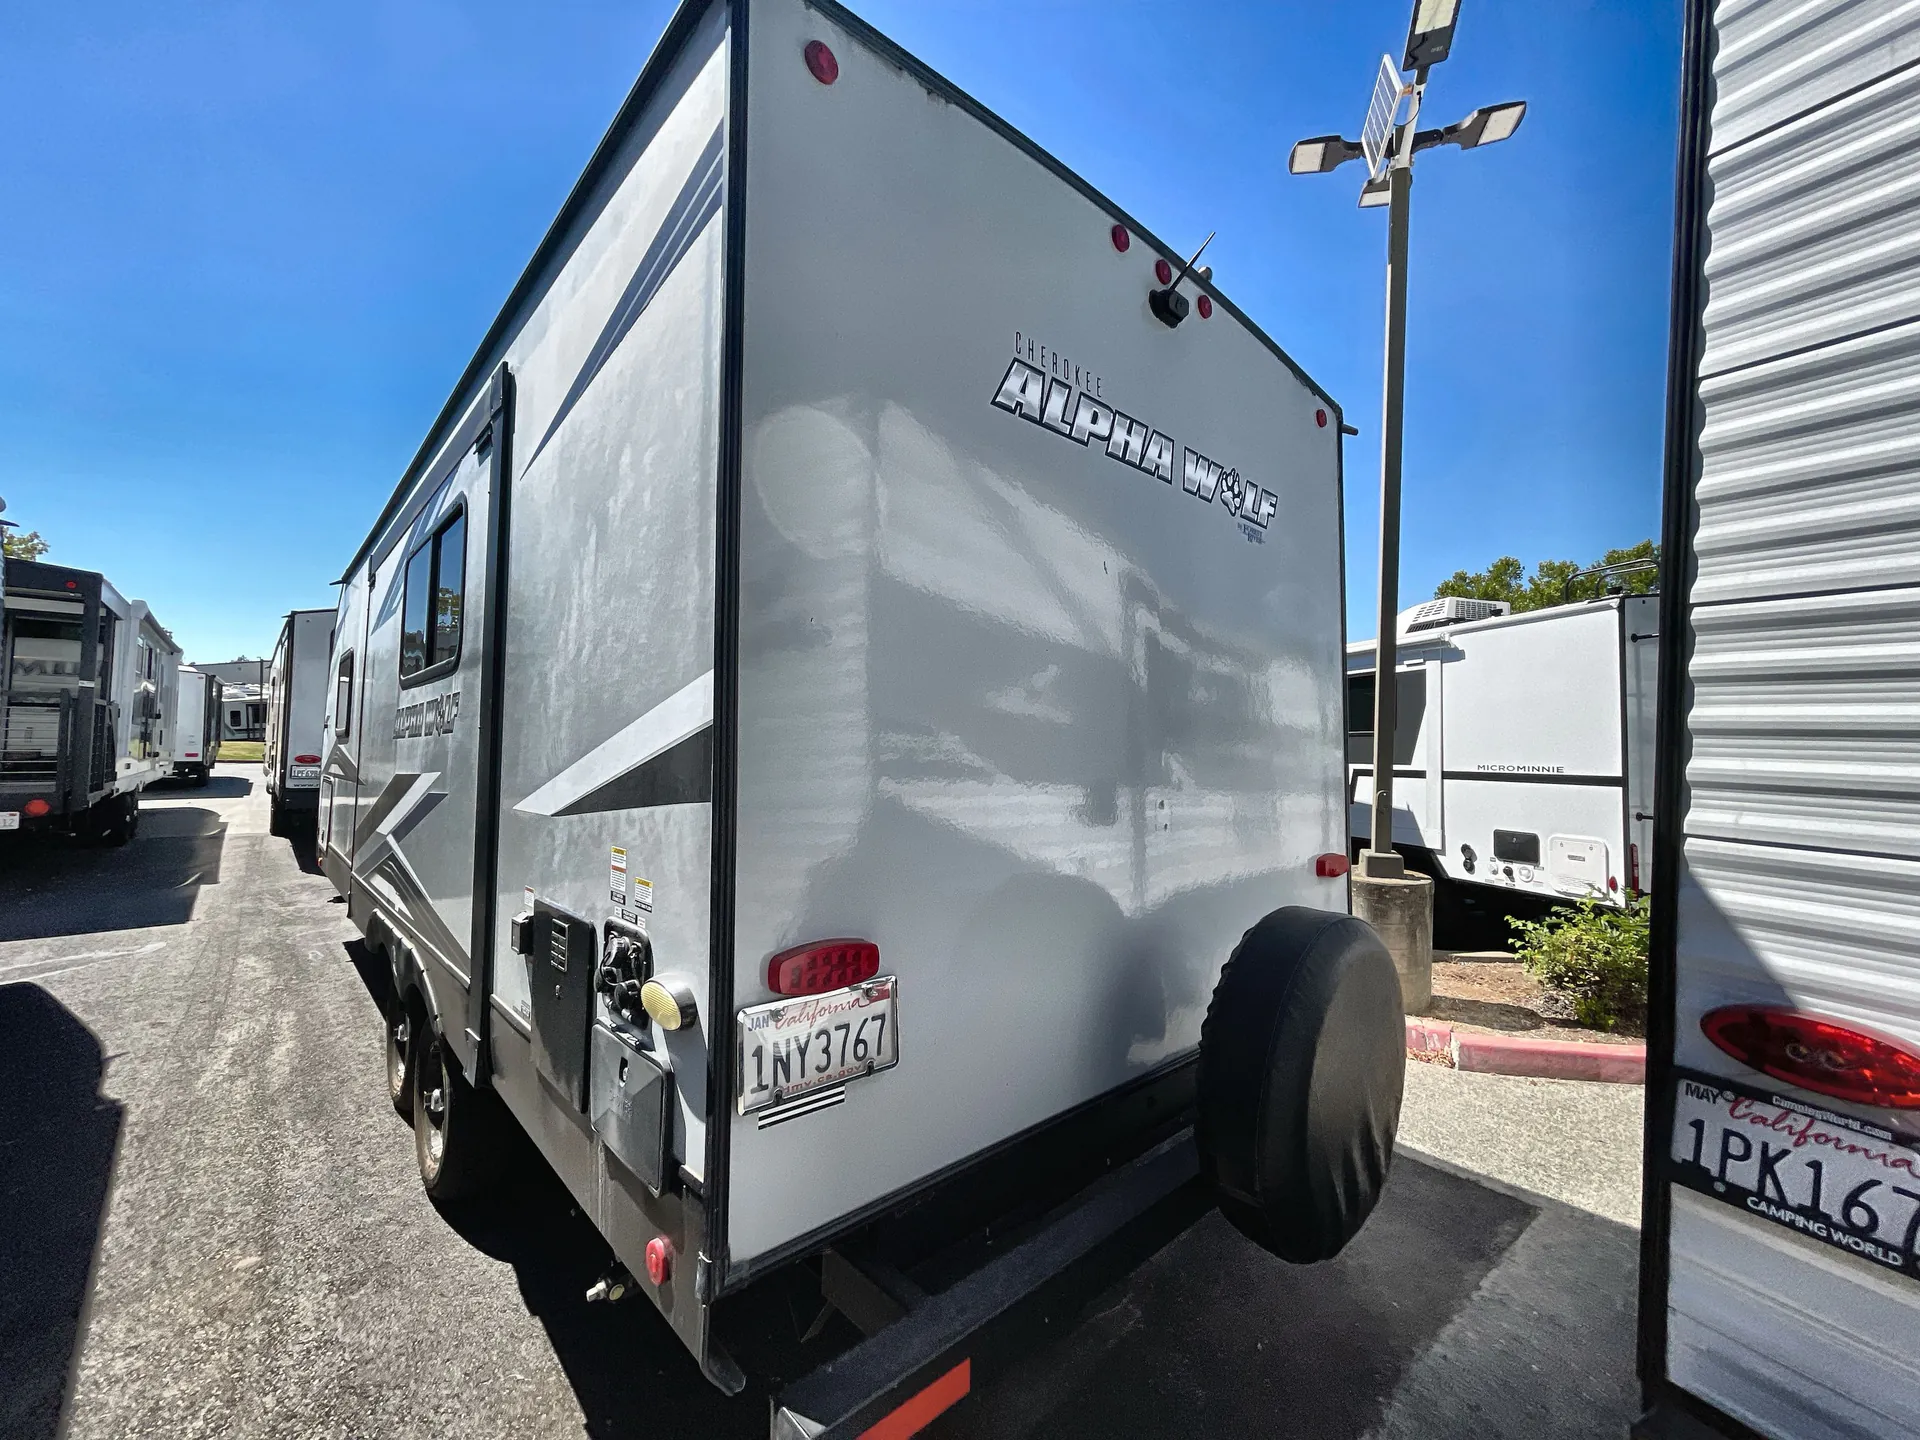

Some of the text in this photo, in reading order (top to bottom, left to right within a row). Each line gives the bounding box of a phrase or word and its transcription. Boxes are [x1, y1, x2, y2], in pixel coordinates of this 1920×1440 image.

[1014, 331, 1102, 398] CHEROKEE
[990, 356, 1175, 486] ALPHA
[1477, 764, 1565, 774] MICROMINNIE
[748, 996, 872, 1032] JAN California
[750, 1013, 886, 1094] 1NY3767
[1685, 1082, 1920, 1179] MAY California
[1746, 1196, 1902, 1265] CAMPING WORLD
